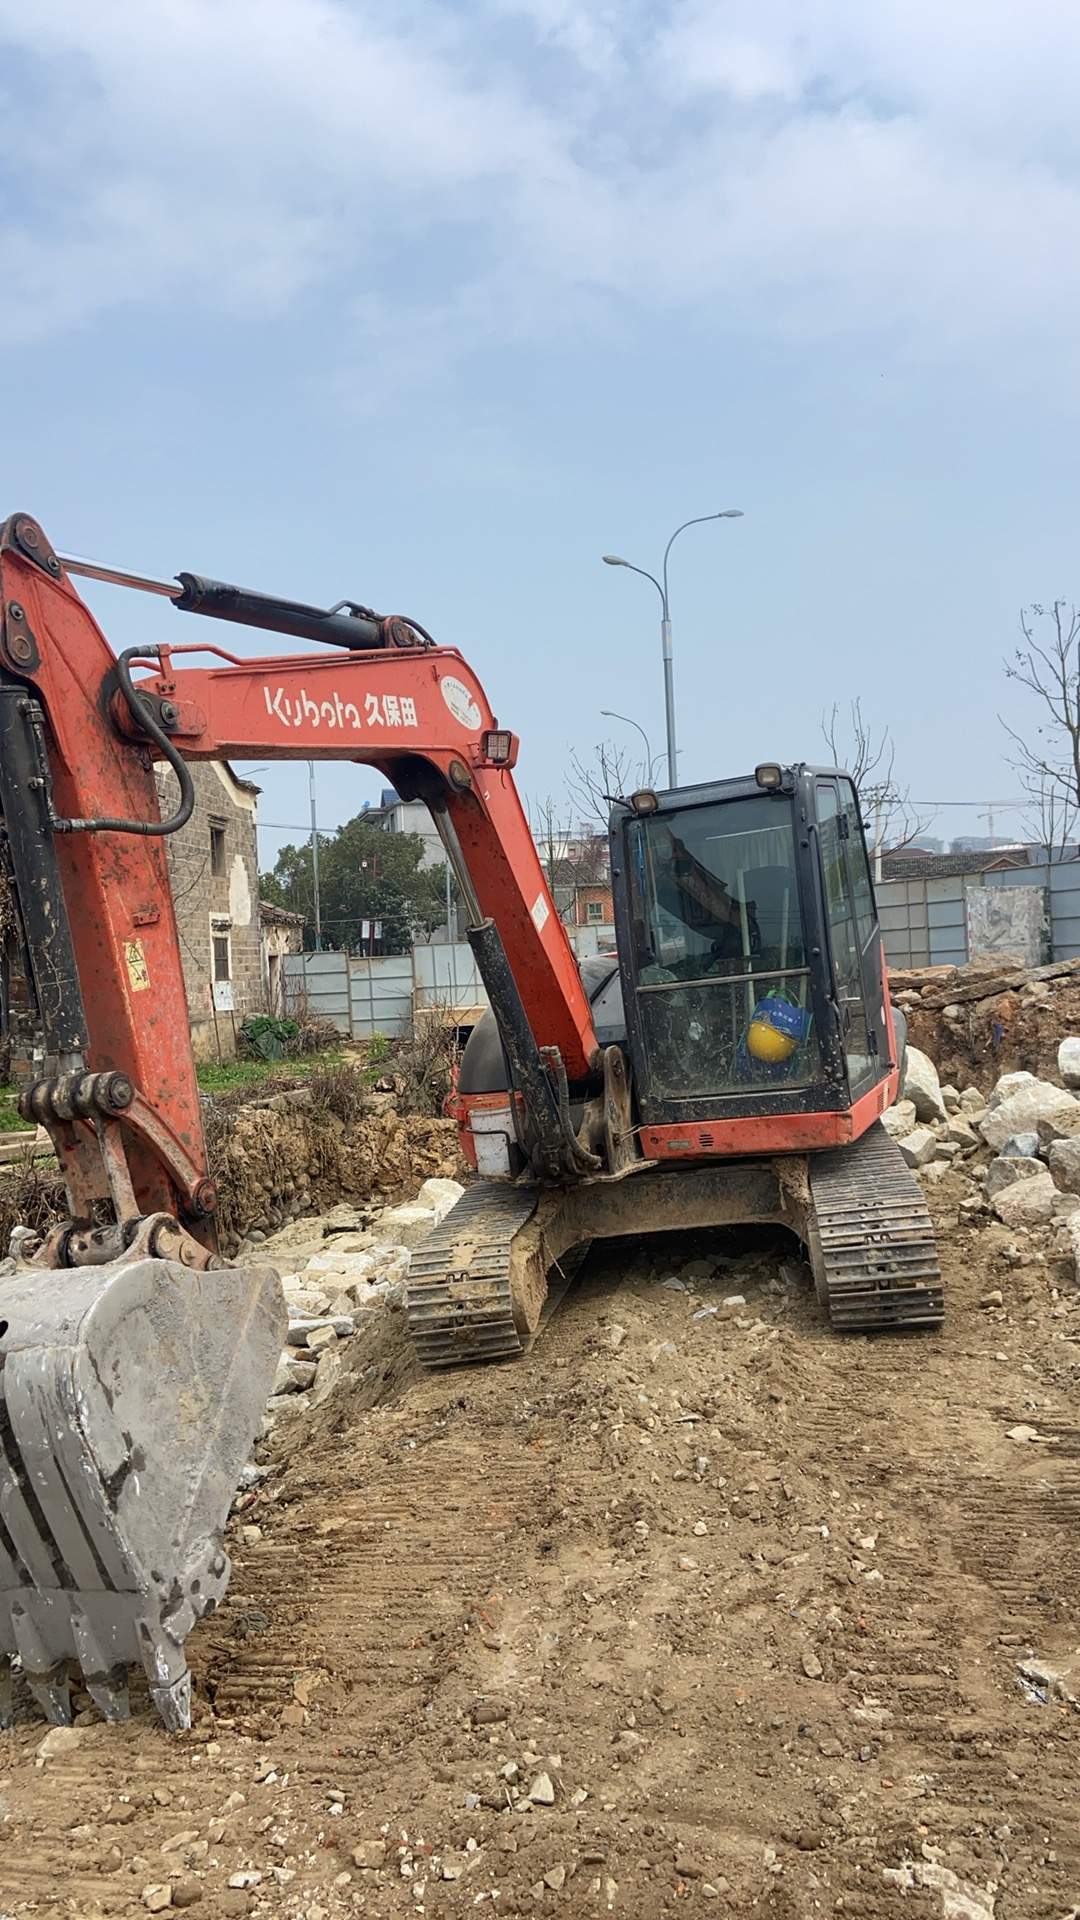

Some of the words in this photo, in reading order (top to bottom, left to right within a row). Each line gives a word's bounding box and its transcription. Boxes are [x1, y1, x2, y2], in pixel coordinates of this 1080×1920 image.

[263, 686, 361, 728] Kubota
[364, 693, 418, 727] 久保田
